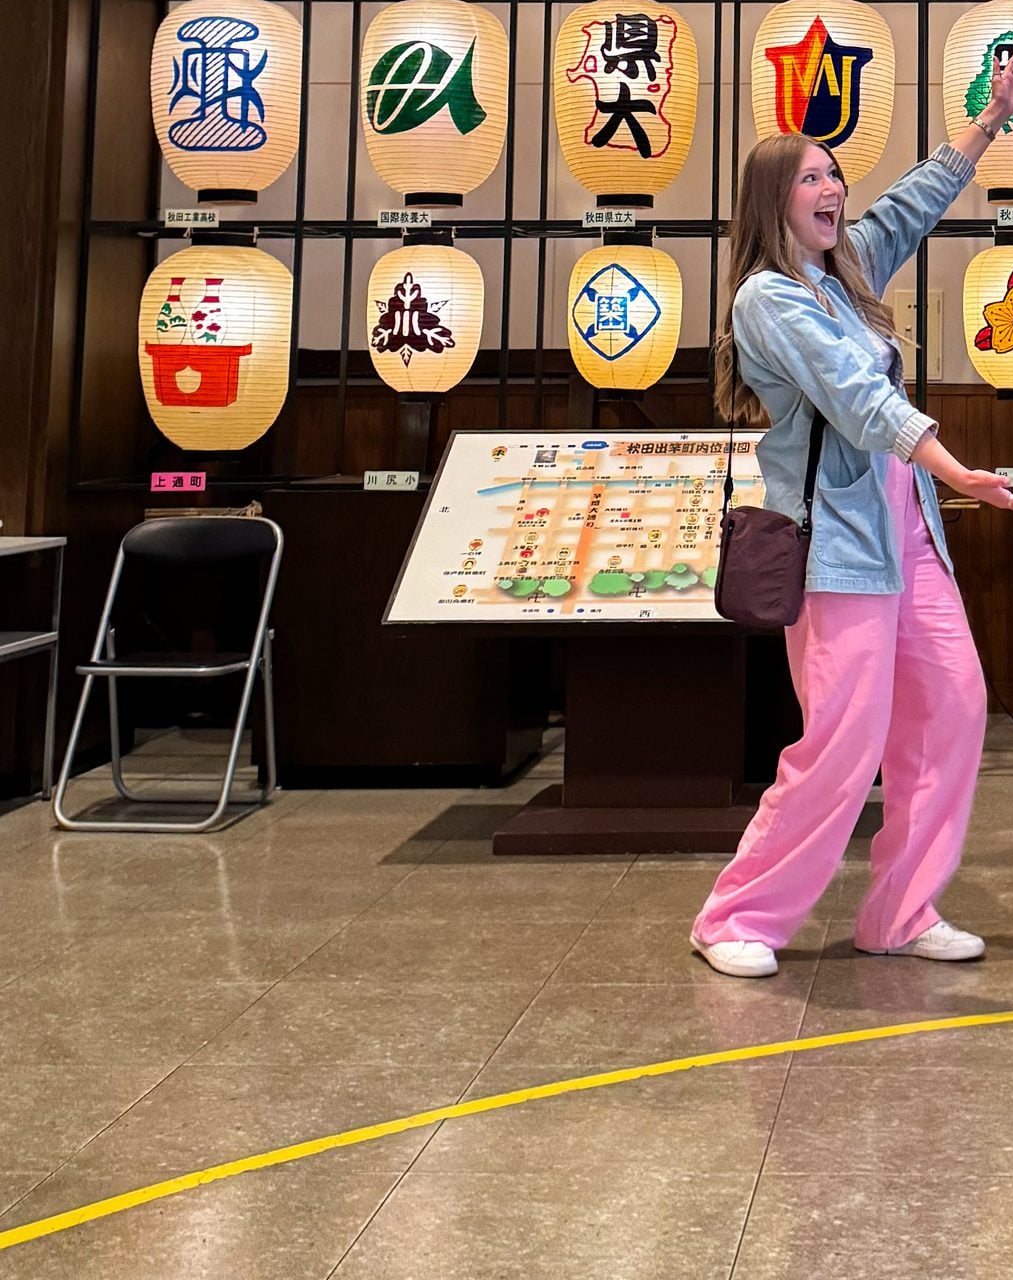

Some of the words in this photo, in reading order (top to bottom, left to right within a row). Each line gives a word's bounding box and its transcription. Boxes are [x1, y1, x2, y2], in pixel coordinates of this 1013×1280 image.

[592, 14, 661, 158] 県大
[168, 212, 216, 222] 秋田工業高校
[380, 212, 429, 223] 国際教養大
[585, 212, 632, 223] 秋田県立大
[154, 476, 201, 488] 上通町
[367, 475, 416, 485] 川尻小
